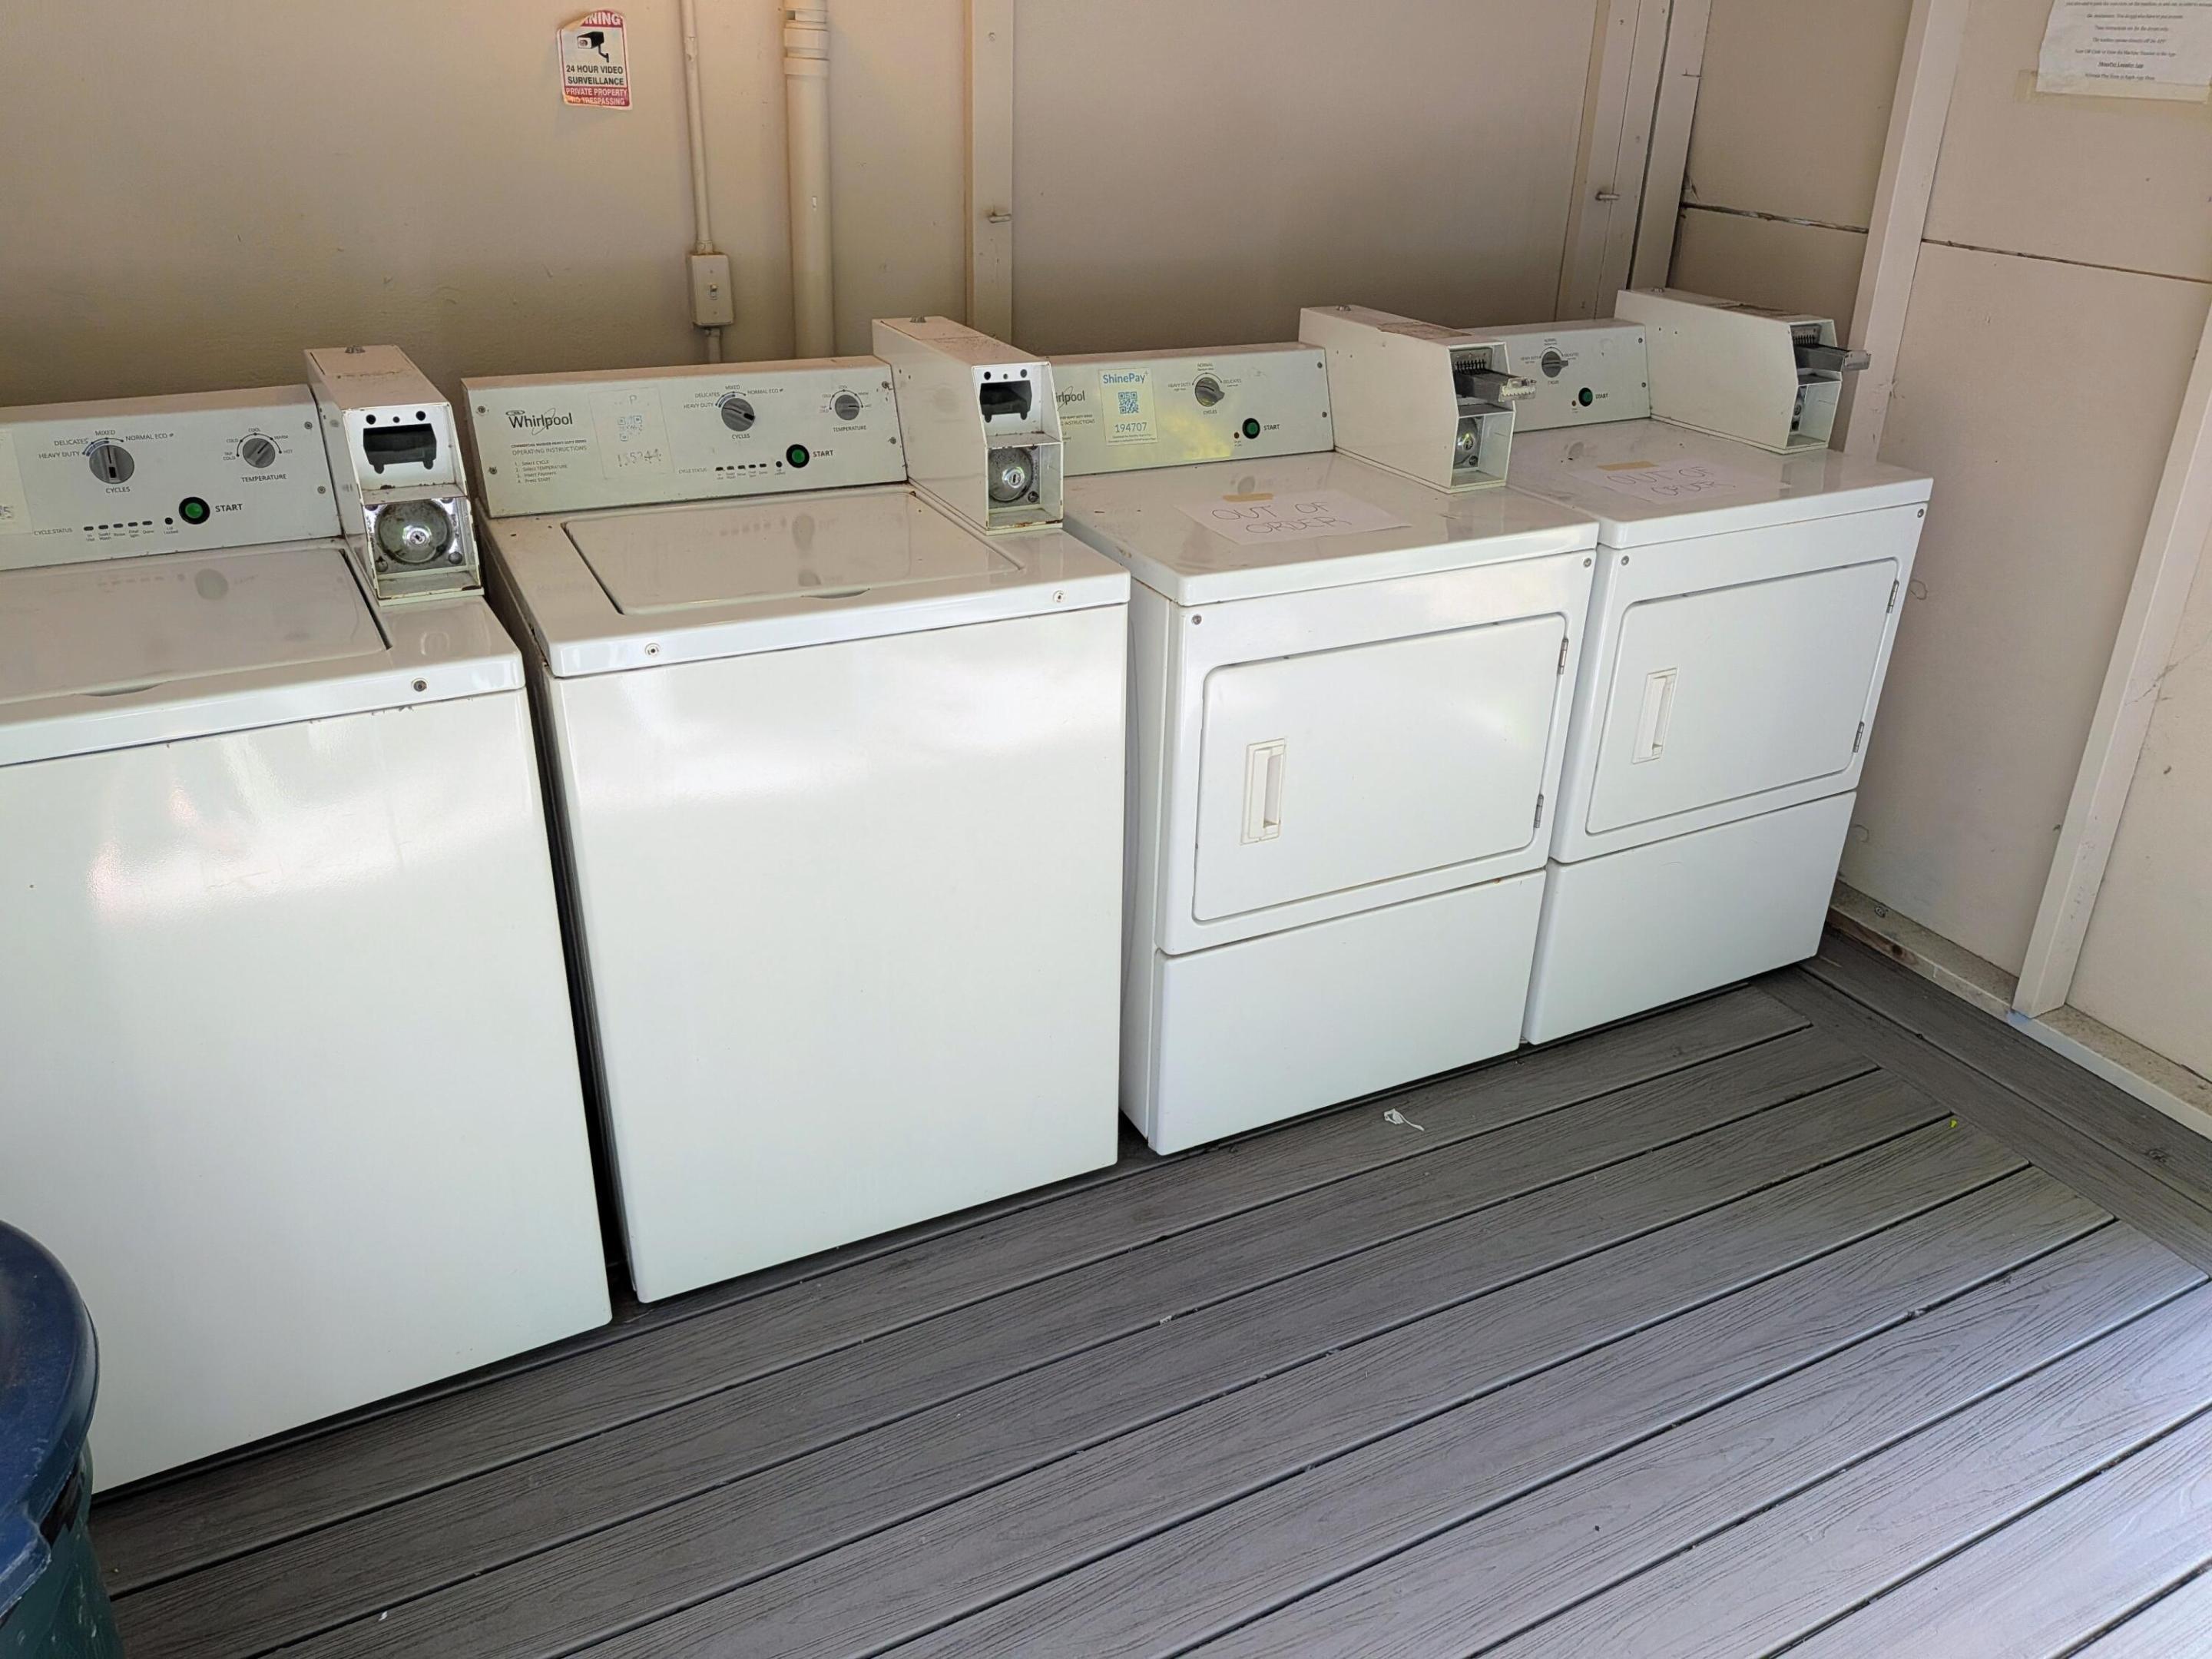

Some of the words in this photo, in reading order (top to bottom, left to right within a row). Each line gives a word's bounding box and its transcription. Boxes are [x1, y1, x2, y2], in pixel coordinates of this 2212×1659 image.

[600, 66, 624, 75] VIDEO
[567, 77, 624, 85] SURVEILLANCE
[594, 88, 628, 97] PROPERTY
[1103, 372, 1146, 384] ShinePay
[507, 412, 573, 430] Whirlpool
[1114, 422, 1147, 432] 194707
[53, 438, 90, 446] DELICATES
[813, 449, 834, 458] START
[240, 473, 289, 483] TEMPERATURE
[214, 503, 243, 513] START
[1211, 505, 1277, 520] OUT
[1294, 502, 1330, 514] OF
[1245, 516, 1353, 534] ORDER
